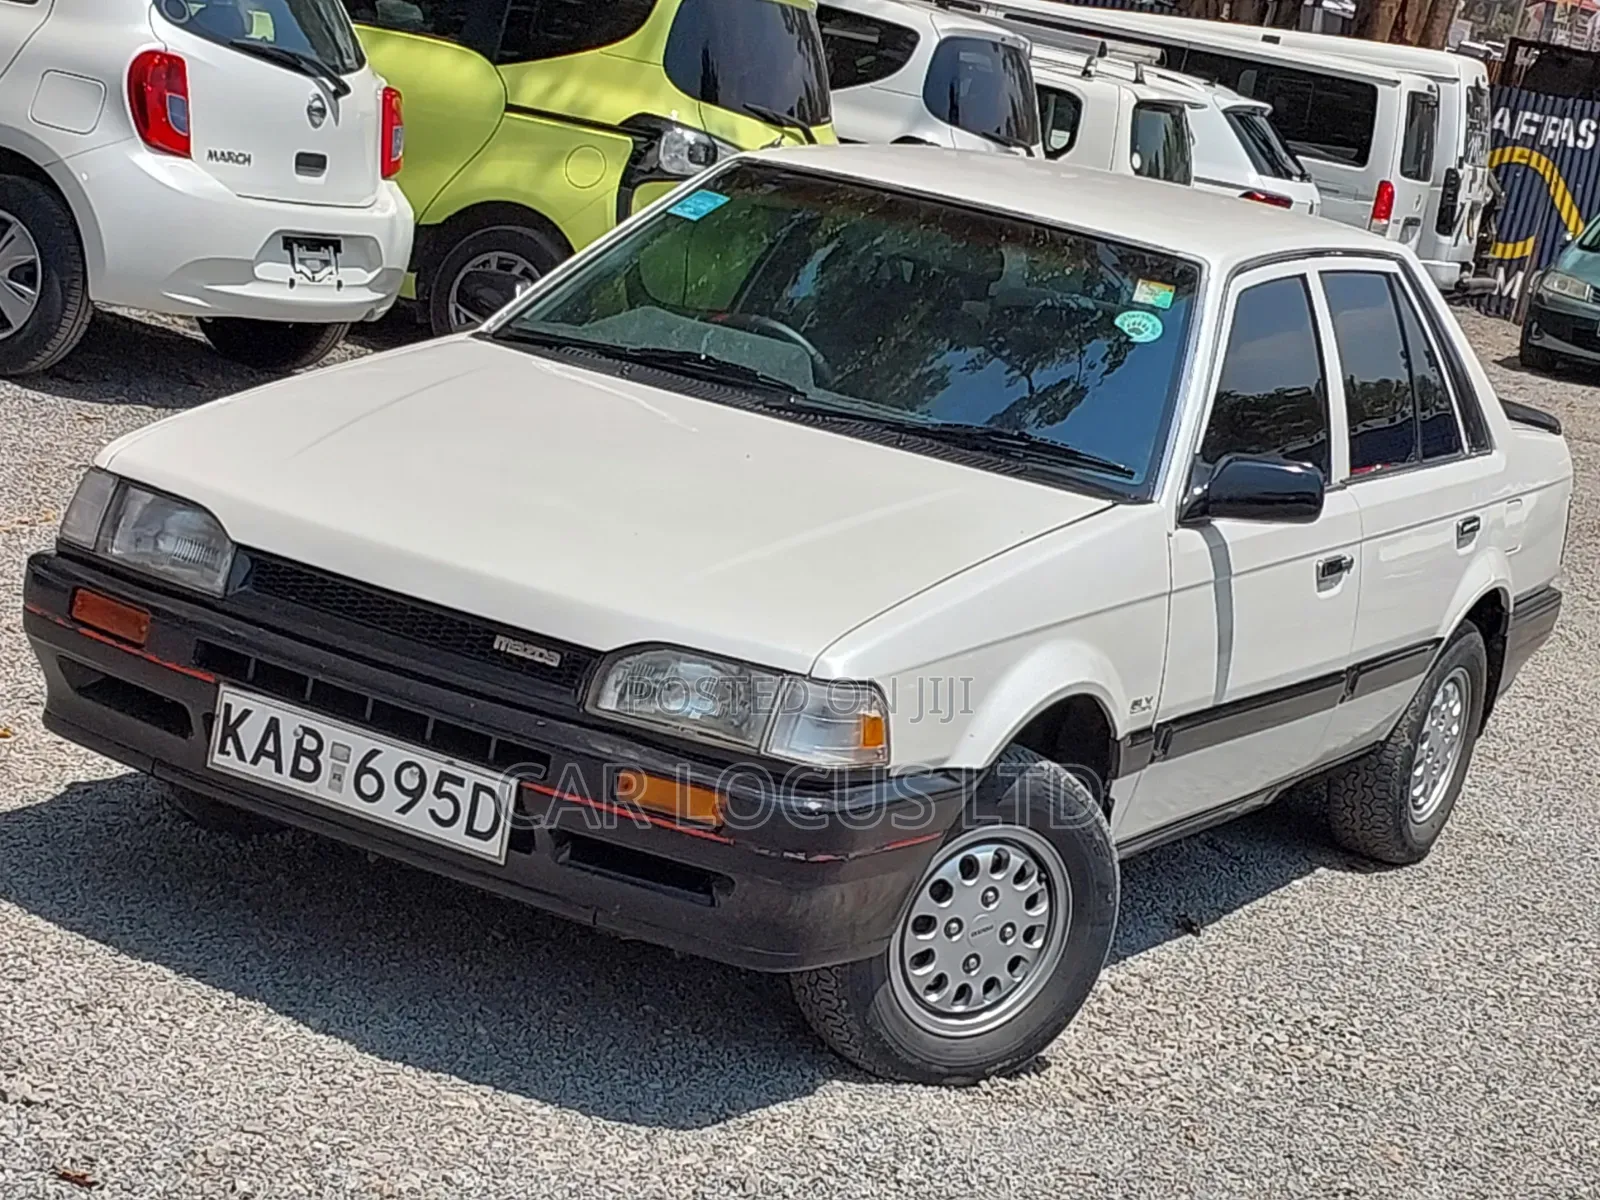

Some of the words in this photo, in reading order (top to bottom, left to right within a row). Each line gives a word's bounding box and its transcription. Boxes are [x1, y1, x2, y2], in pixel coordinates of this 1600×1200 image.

[207, 149, 251, 167] MARCH
[493, 635, 561, 668] mazda
[217, 702, 325, 784] KAB
[353, 748, 502, 842] 695D
